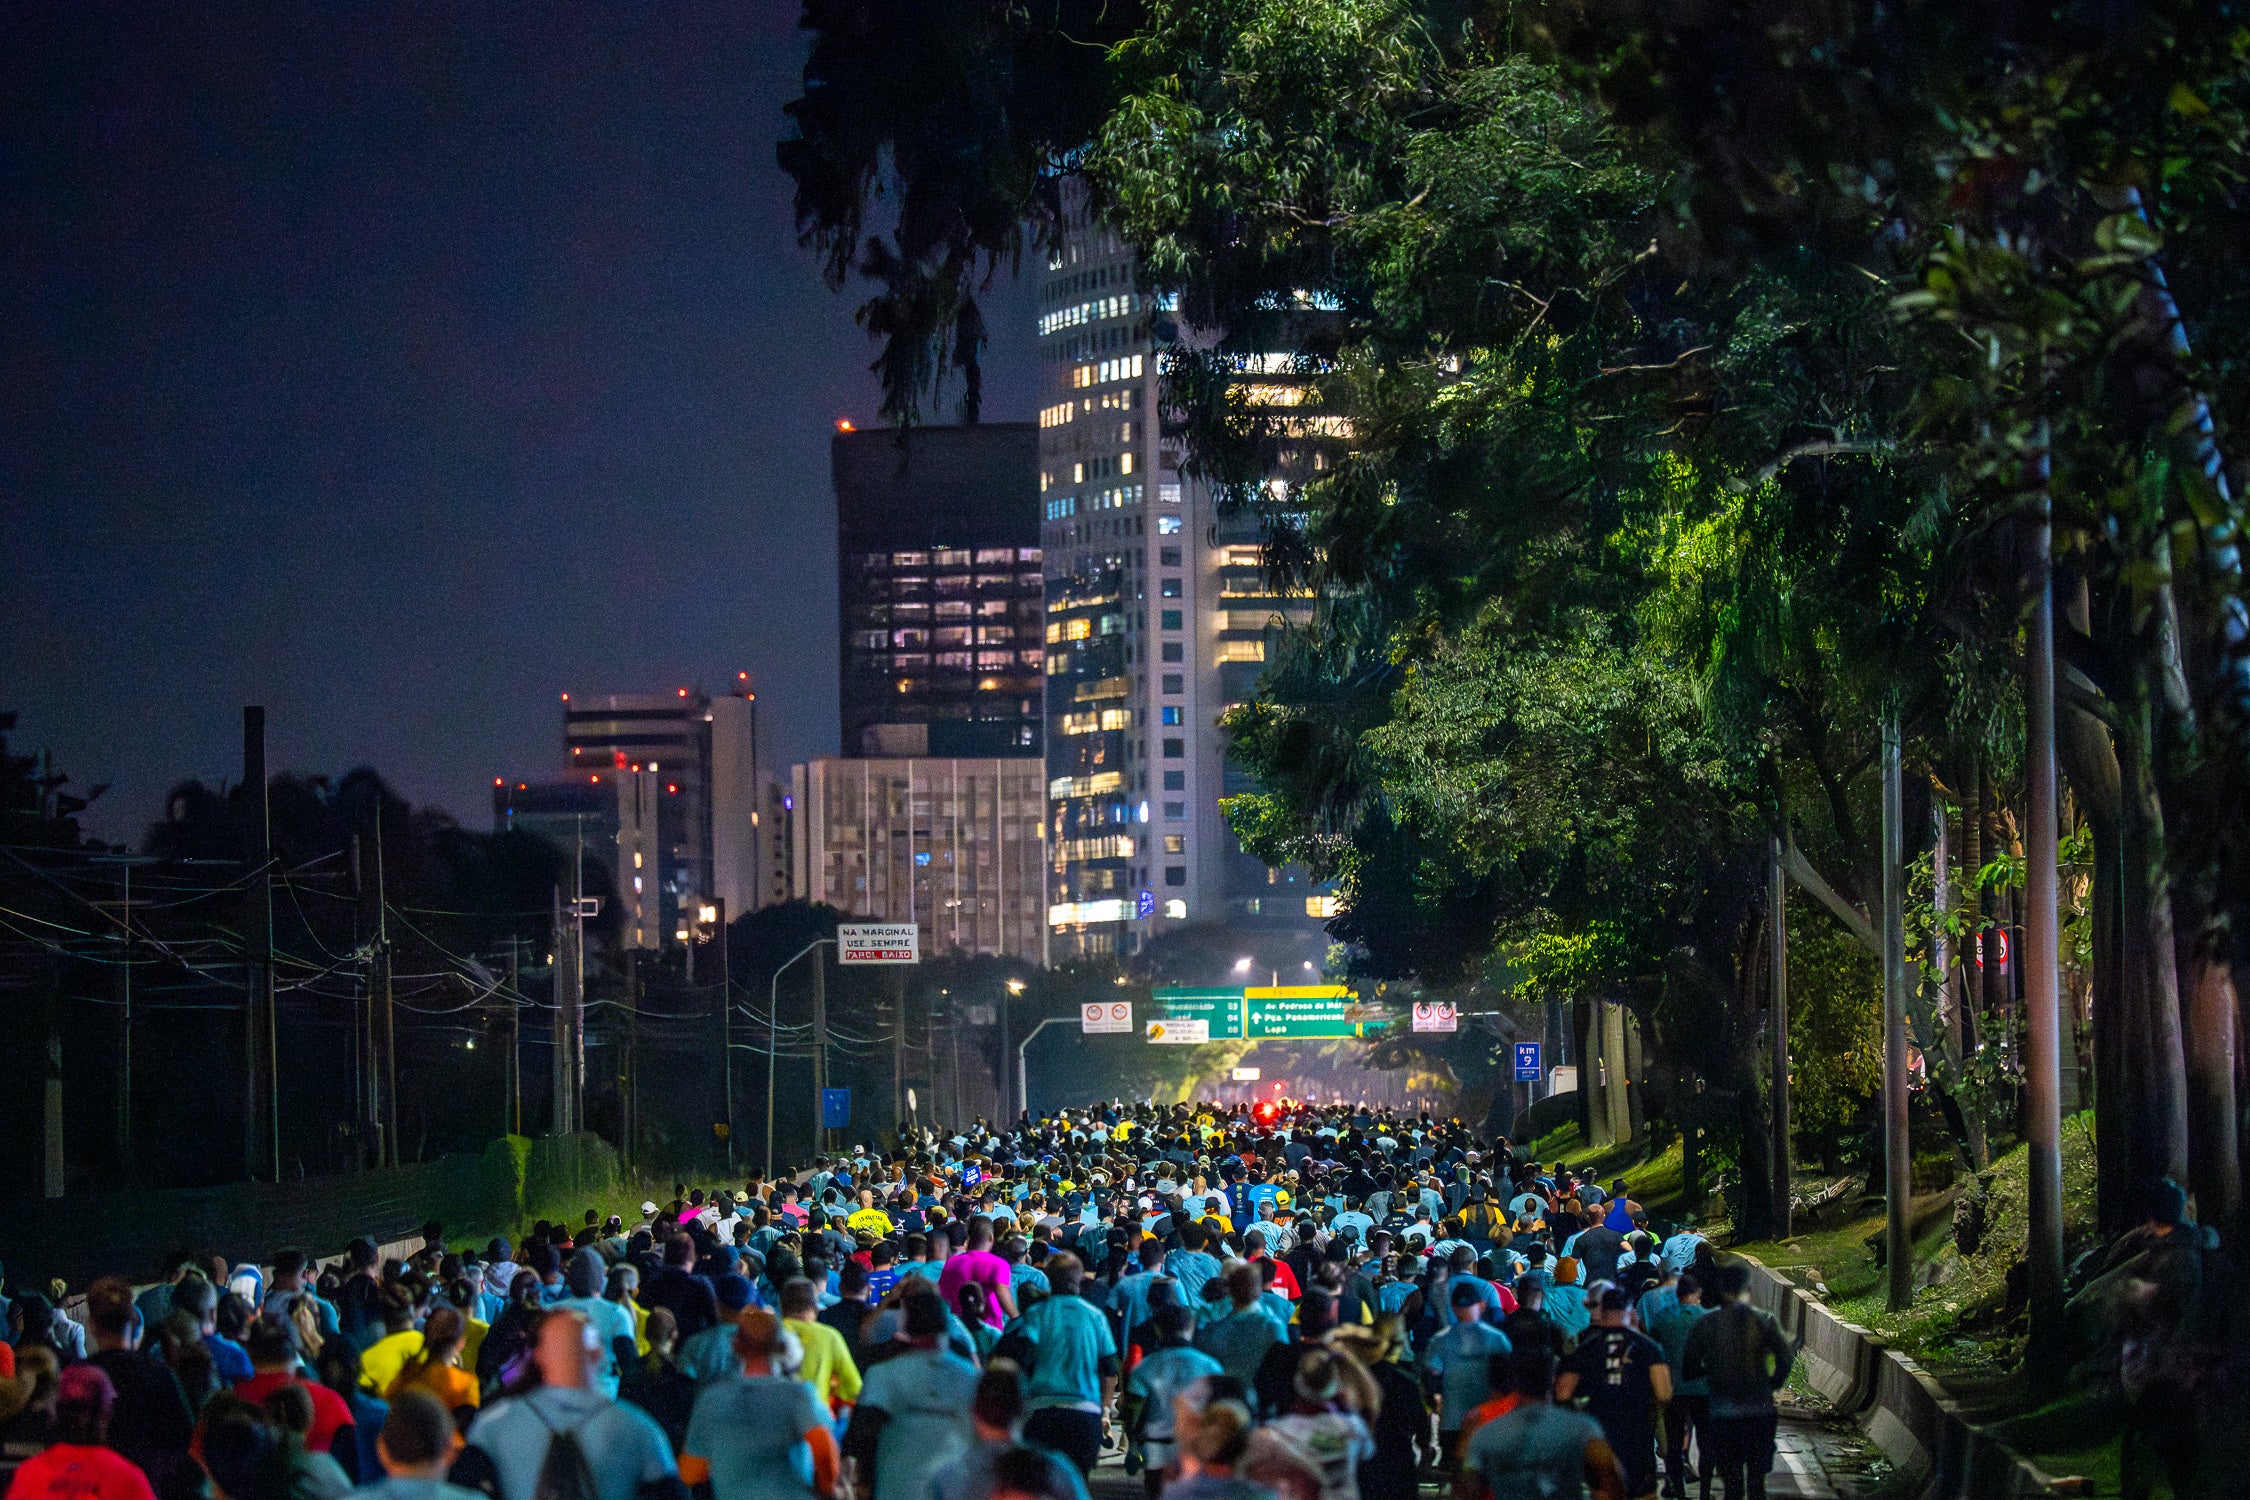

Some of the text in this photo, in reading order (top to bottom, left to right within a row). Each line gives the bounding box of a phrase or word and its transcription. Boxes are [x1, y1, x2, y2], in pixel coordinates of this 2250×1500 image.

[843, 927, 914, 936] NA MARGINAL
[847, 939, 911, 948] USE SEMPRE
[846, 950, 911, 959] FAROL BAIXO
[1519, 1046, 1535, 1055] km
[1524, 1055, 1532, 1066] 9
